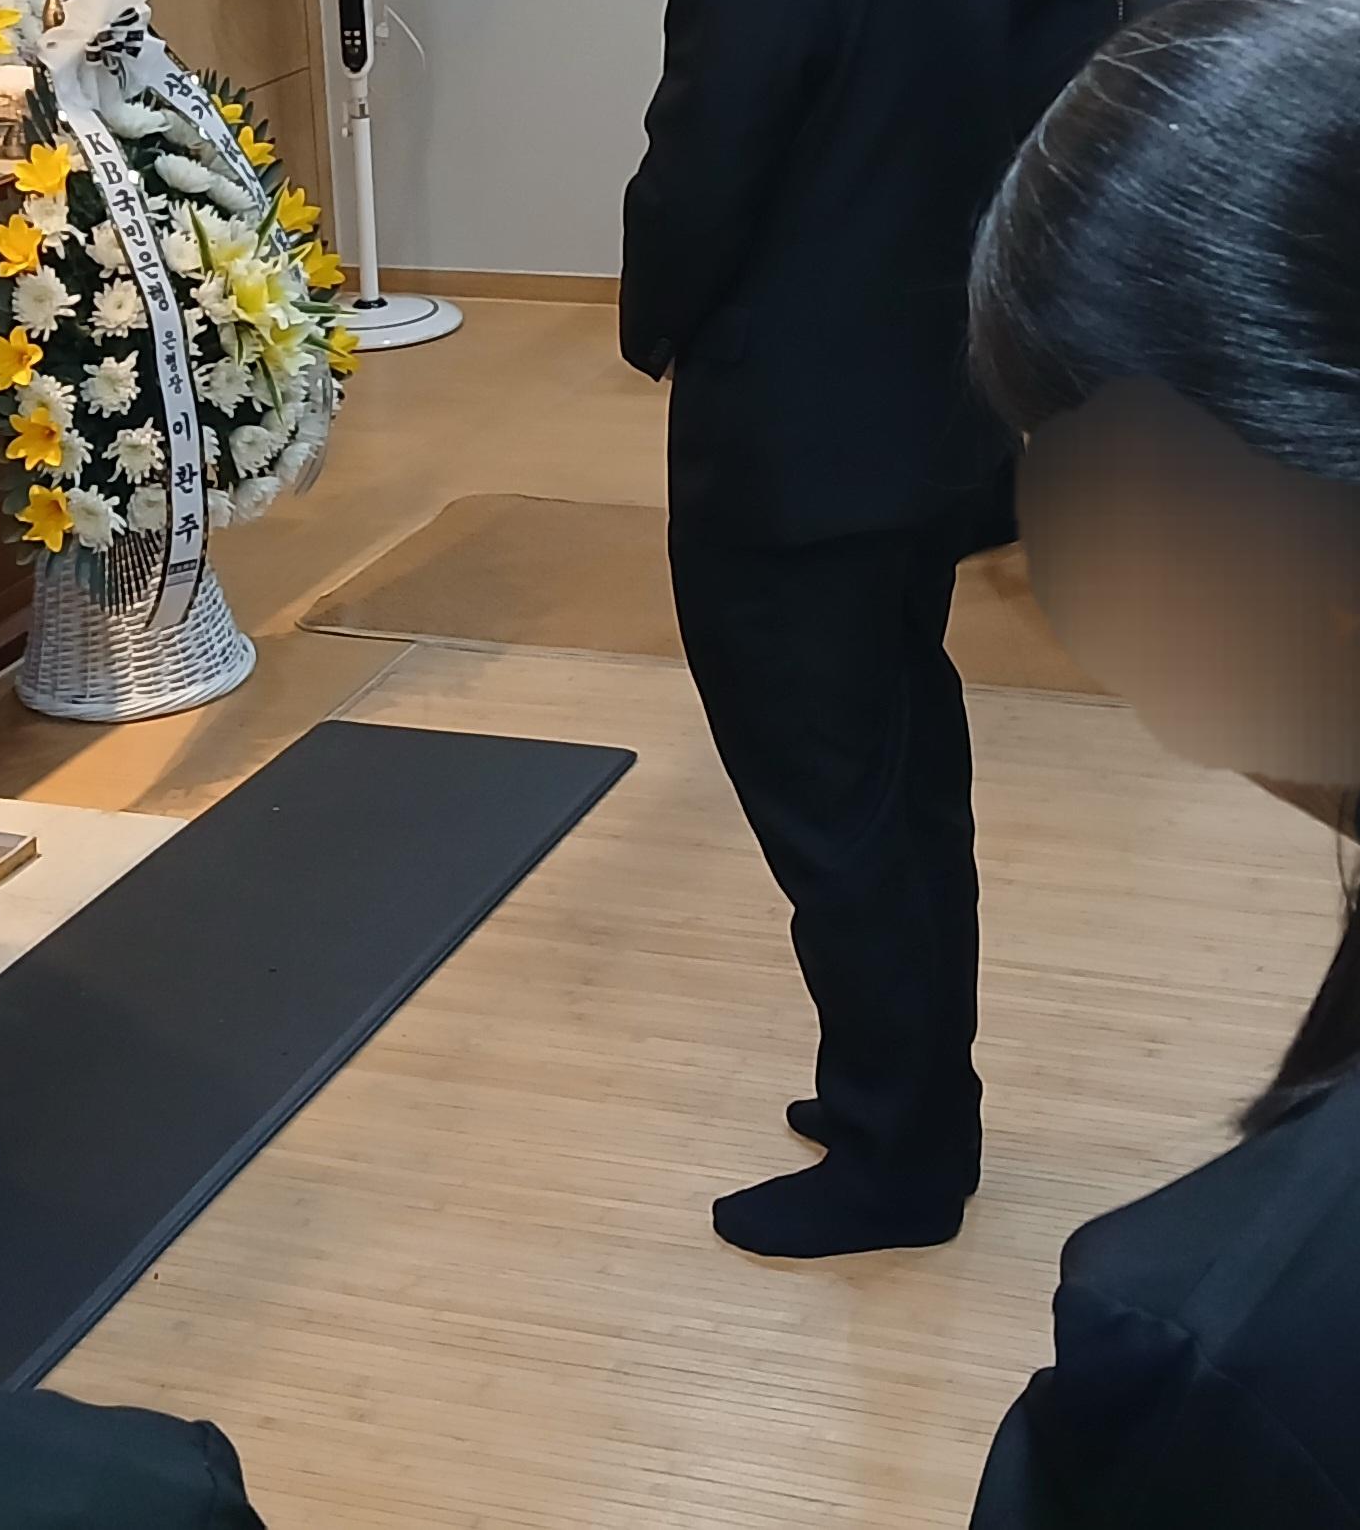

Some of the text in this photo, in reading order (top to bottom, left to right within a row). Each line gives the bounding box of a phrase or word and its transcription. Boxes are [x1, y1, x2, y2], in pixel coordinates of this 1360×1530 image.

[163, 72, 214, 120] 삼가
[84, 131, 170, 312] KB국민은행
[162, 330, 183, 395] 은행장
[172, 411, 200, 544] 이환주
